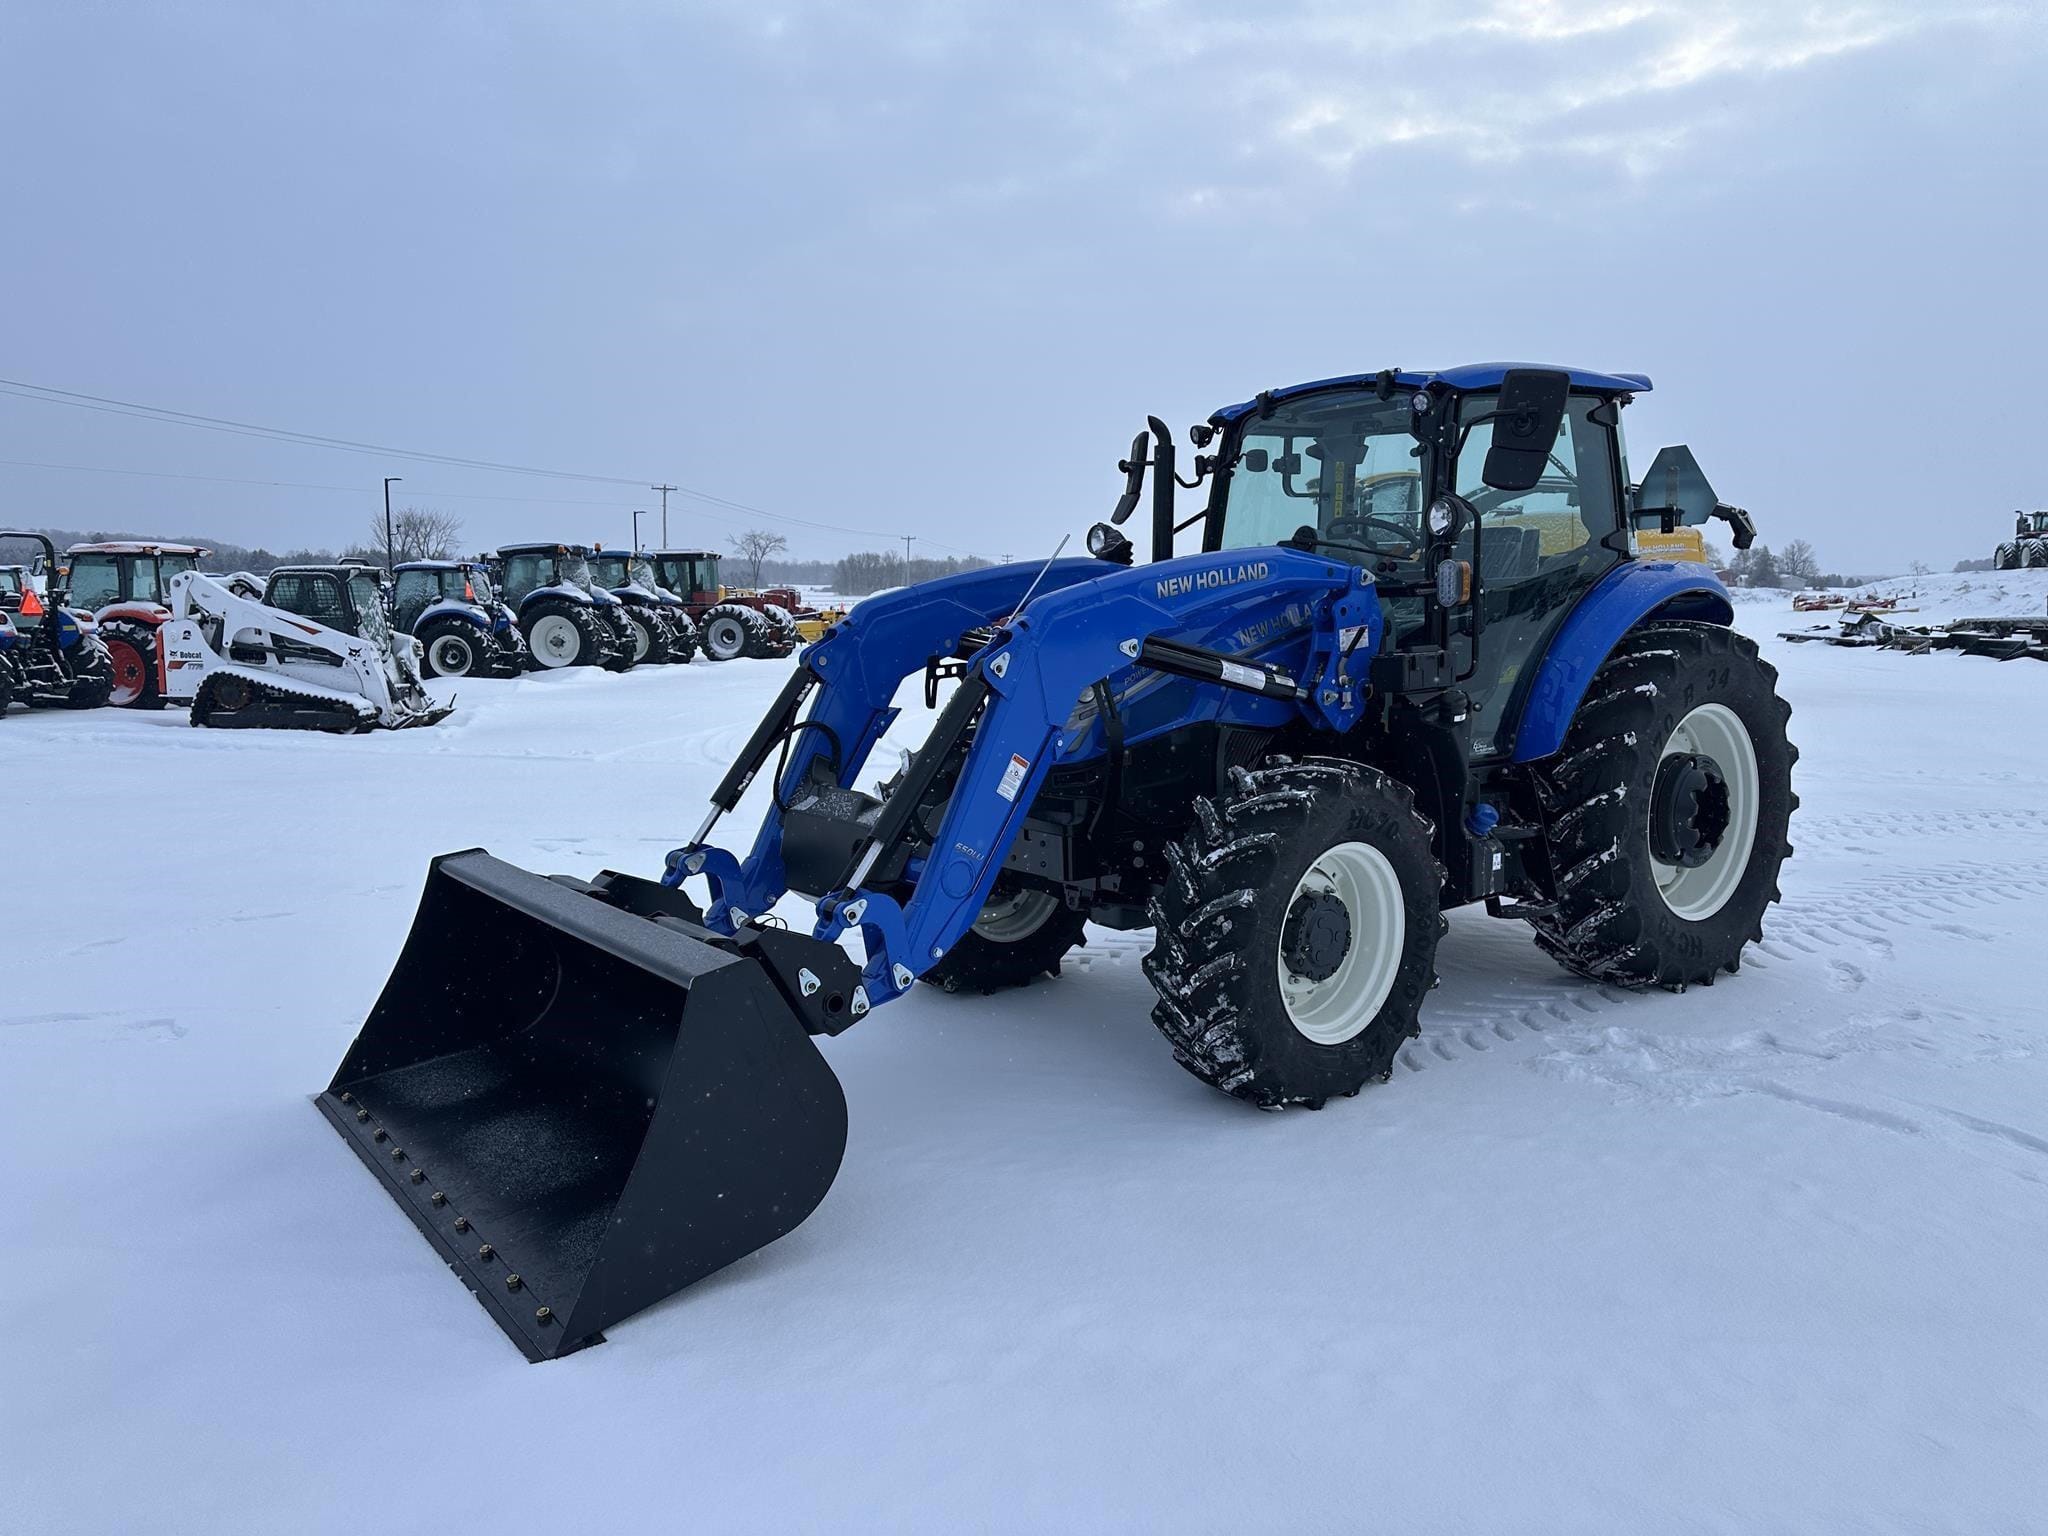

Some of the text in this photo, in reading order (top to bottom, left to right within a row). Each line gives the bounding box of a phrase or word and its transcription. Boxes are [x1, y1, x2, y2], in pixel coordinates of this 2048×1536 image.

[1156, 562, 1268, 599] NEW HOLLAND
[1239, 600, 1318, 646] NEW HOLLA
[180, 651, 202, 659] Bobcat
[1706, 667, 1730, 692] 34
